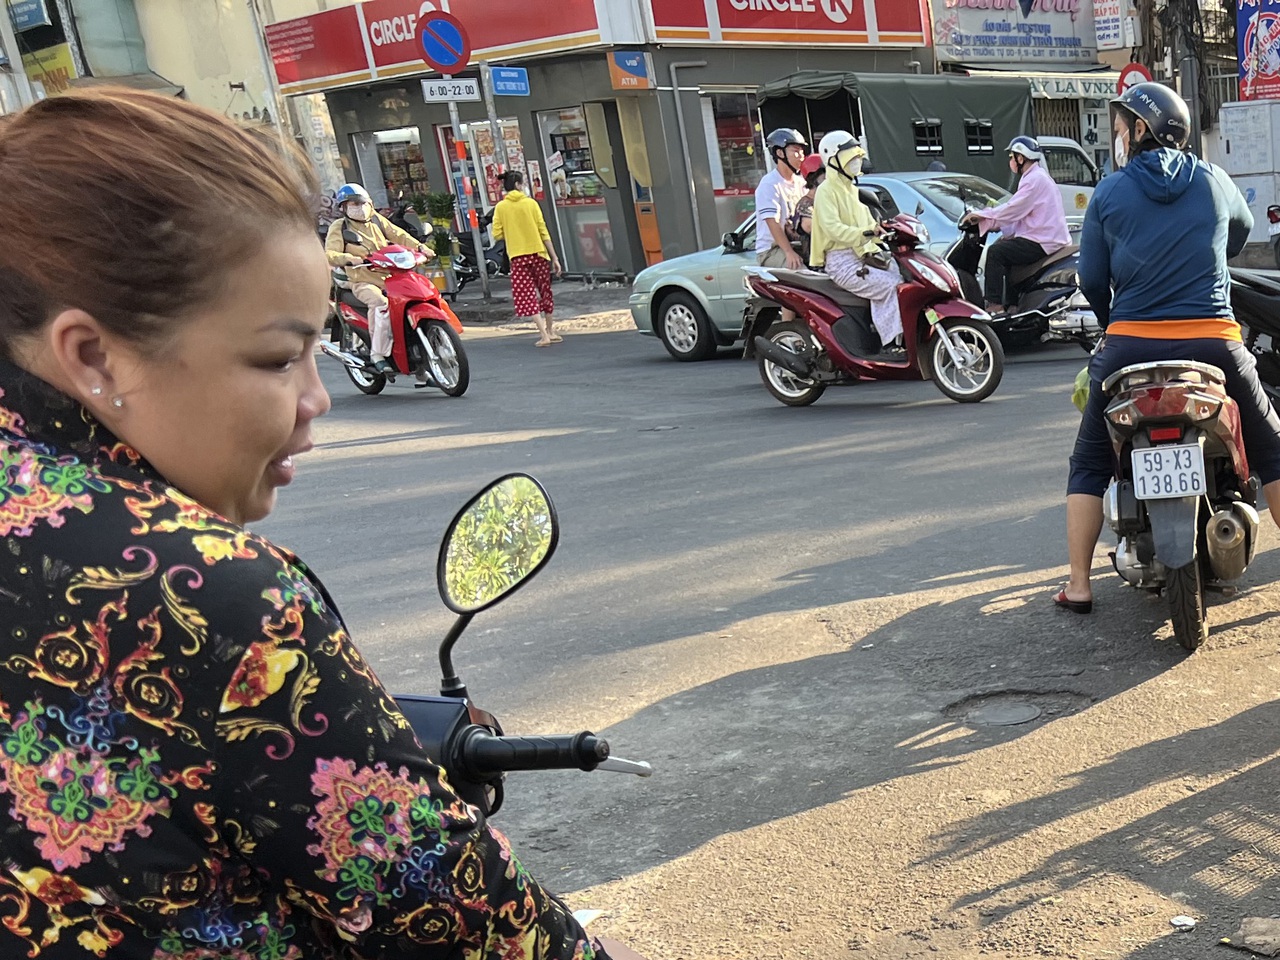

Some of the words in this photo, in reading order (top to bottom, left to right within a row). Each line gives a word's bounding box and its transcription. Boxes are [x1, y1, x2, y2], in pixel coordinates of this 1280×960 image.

[621, 77, 638, 85] ATM
[1143, 449, 1192, 473] 59-X3
[1138, 472, 1200, 495] 138.66
